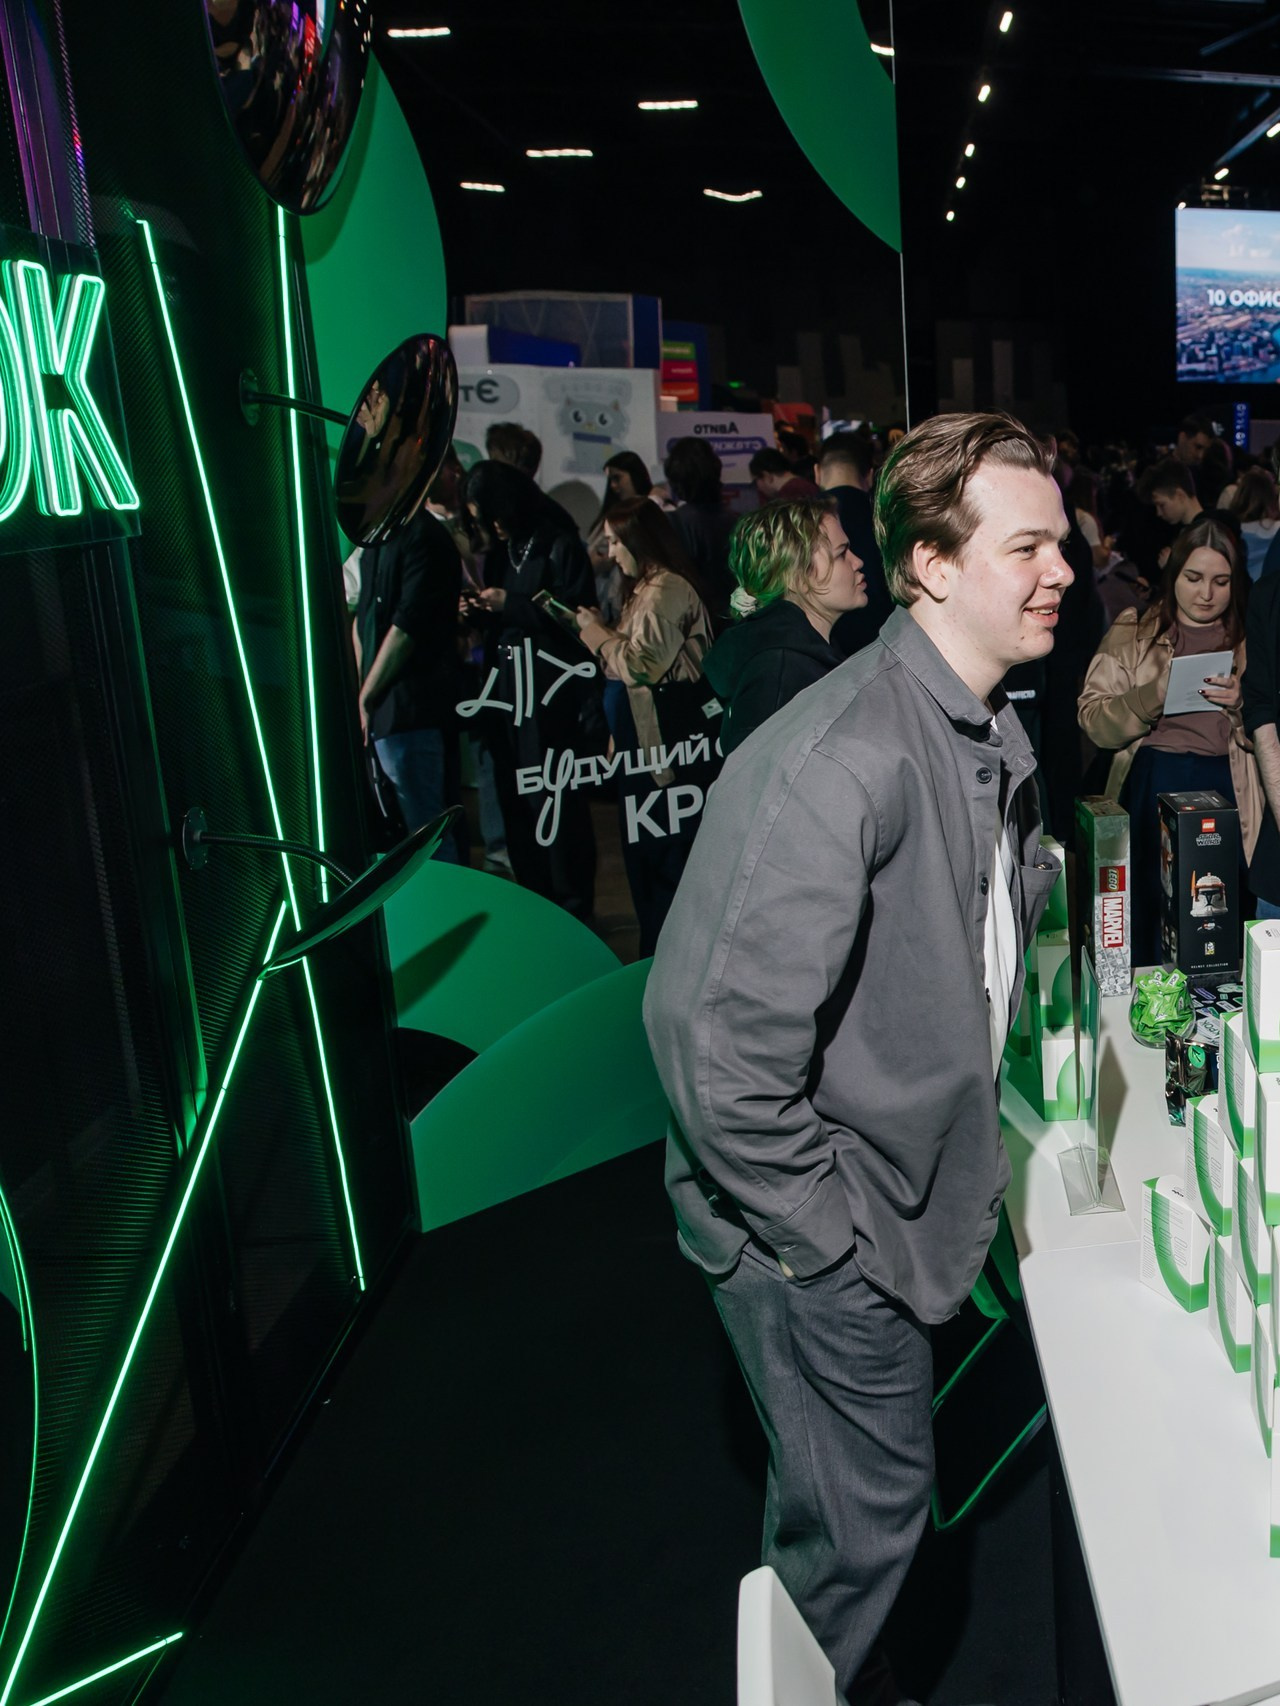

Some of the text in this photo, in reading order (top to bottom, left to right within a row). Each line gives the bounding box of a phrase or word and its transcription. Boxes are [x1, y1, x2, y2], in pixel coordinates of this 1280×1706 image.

[1207, 288, 1226, 306] 10
[1108, 868, 1119, 891] LEGO
[1103, 897, 1124, 949] MARVEL
